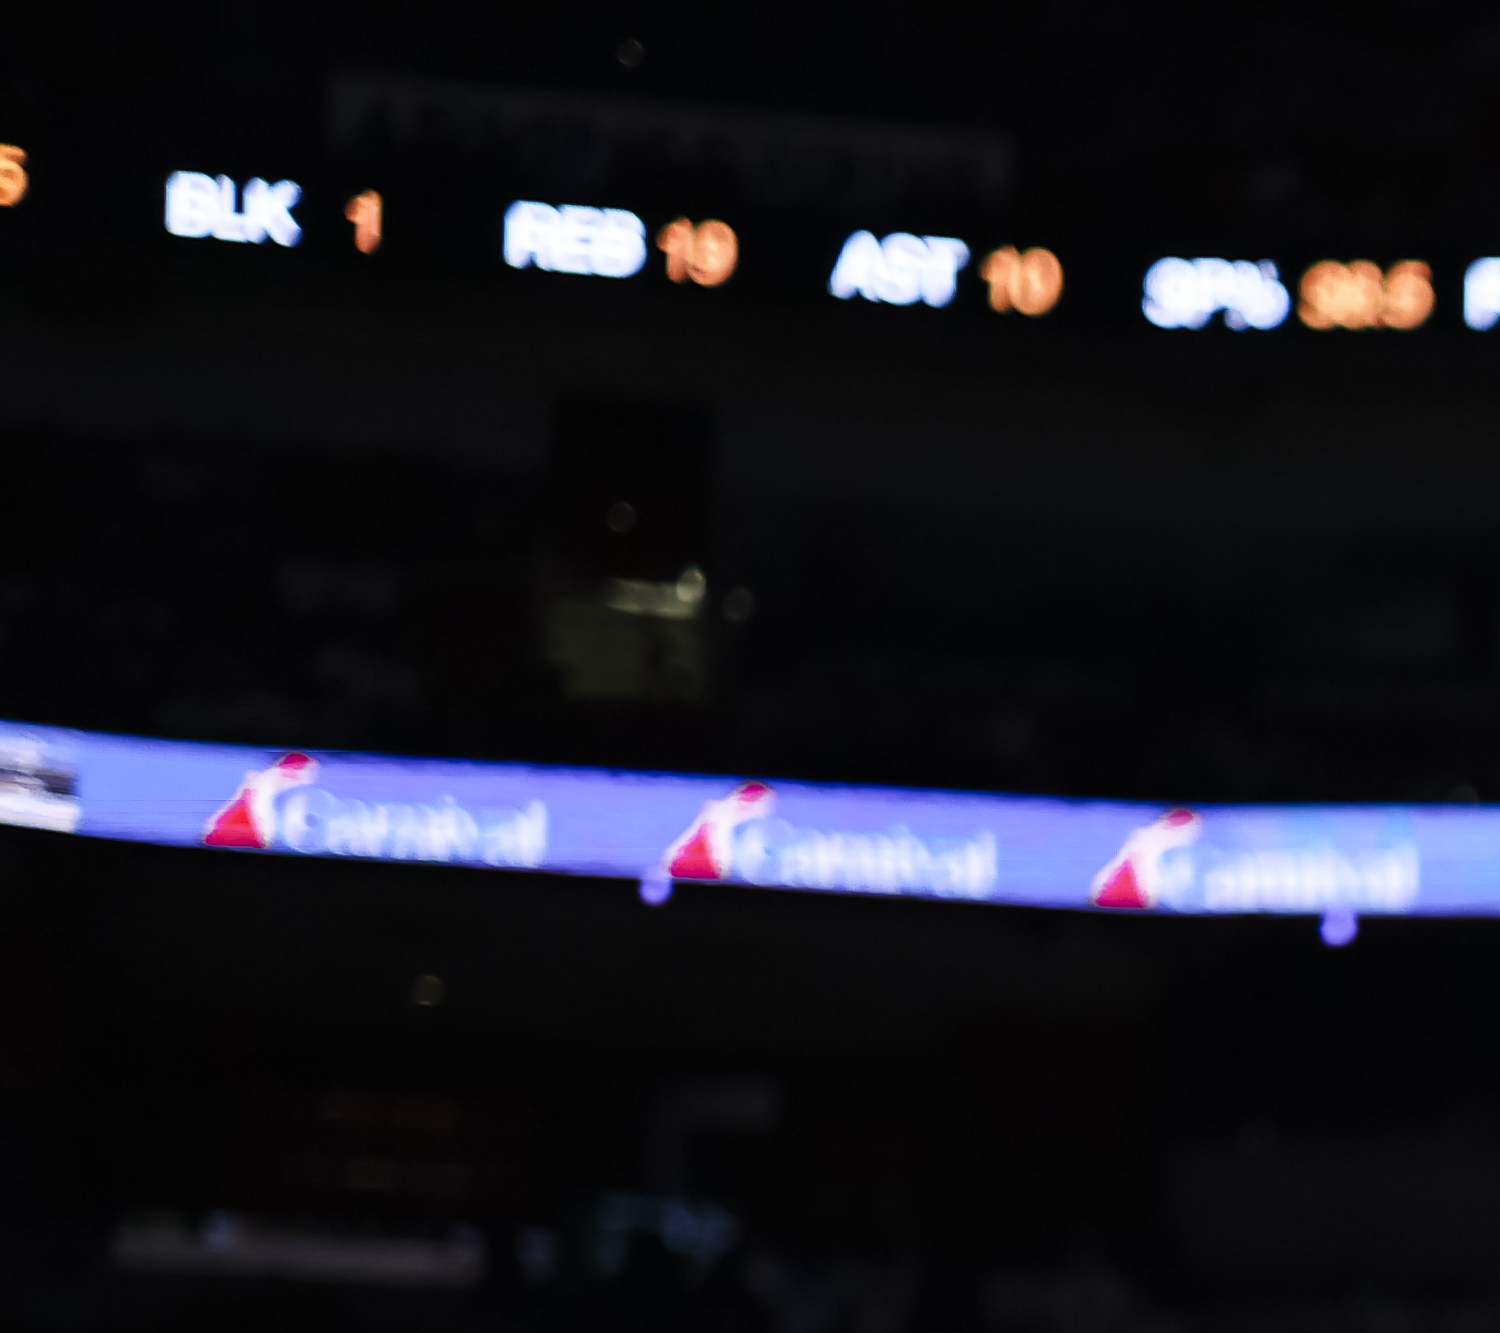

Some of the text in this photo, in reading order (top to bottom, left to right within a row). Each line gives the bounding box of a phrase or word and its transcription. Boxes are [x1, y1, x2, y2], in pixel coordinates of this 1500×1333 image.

[165, 171, 302, 247] BLK
[347, 192, 381, 252] 1
[503, 200, 647, 278] REB
[829, 230, 970, 307] AST
